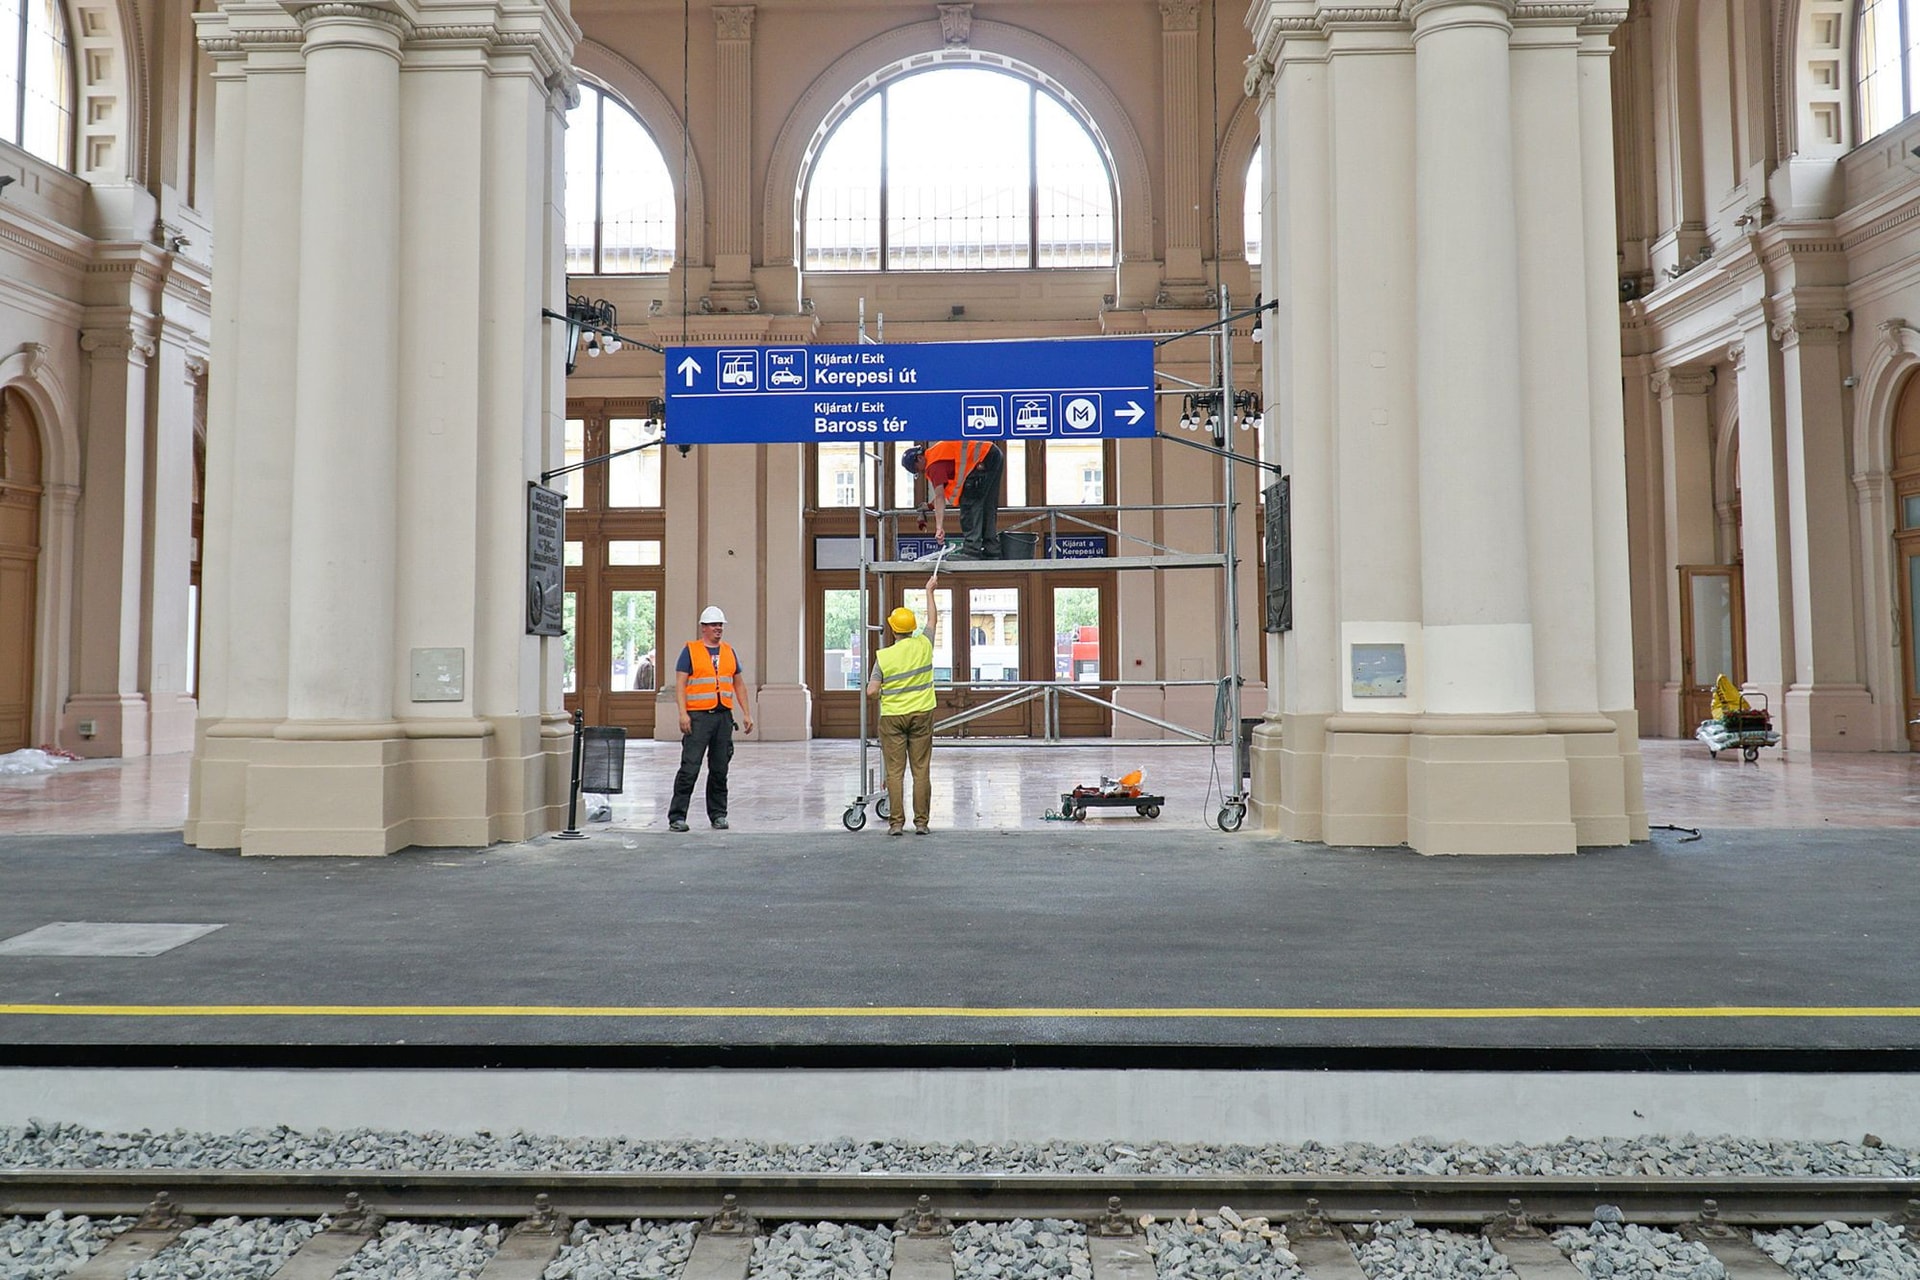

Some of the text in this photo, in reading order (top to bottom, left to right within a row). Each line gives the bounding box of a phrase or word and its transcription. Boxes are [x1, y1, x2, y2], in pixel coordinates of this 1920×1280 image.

[771, 354, 794, 365] Taxi
[814, 353, 885, 367] Kijárat / Exit
[815, 367, 917, 387] Kerepesi út
[814, 402, 885, 415] Kijárat / Exit
[815, 416, 908, 433] Baross tér
[1062, 540, 1087, 548] Kijárat
[1062, 547, 1104, 556] Kerepesi út
